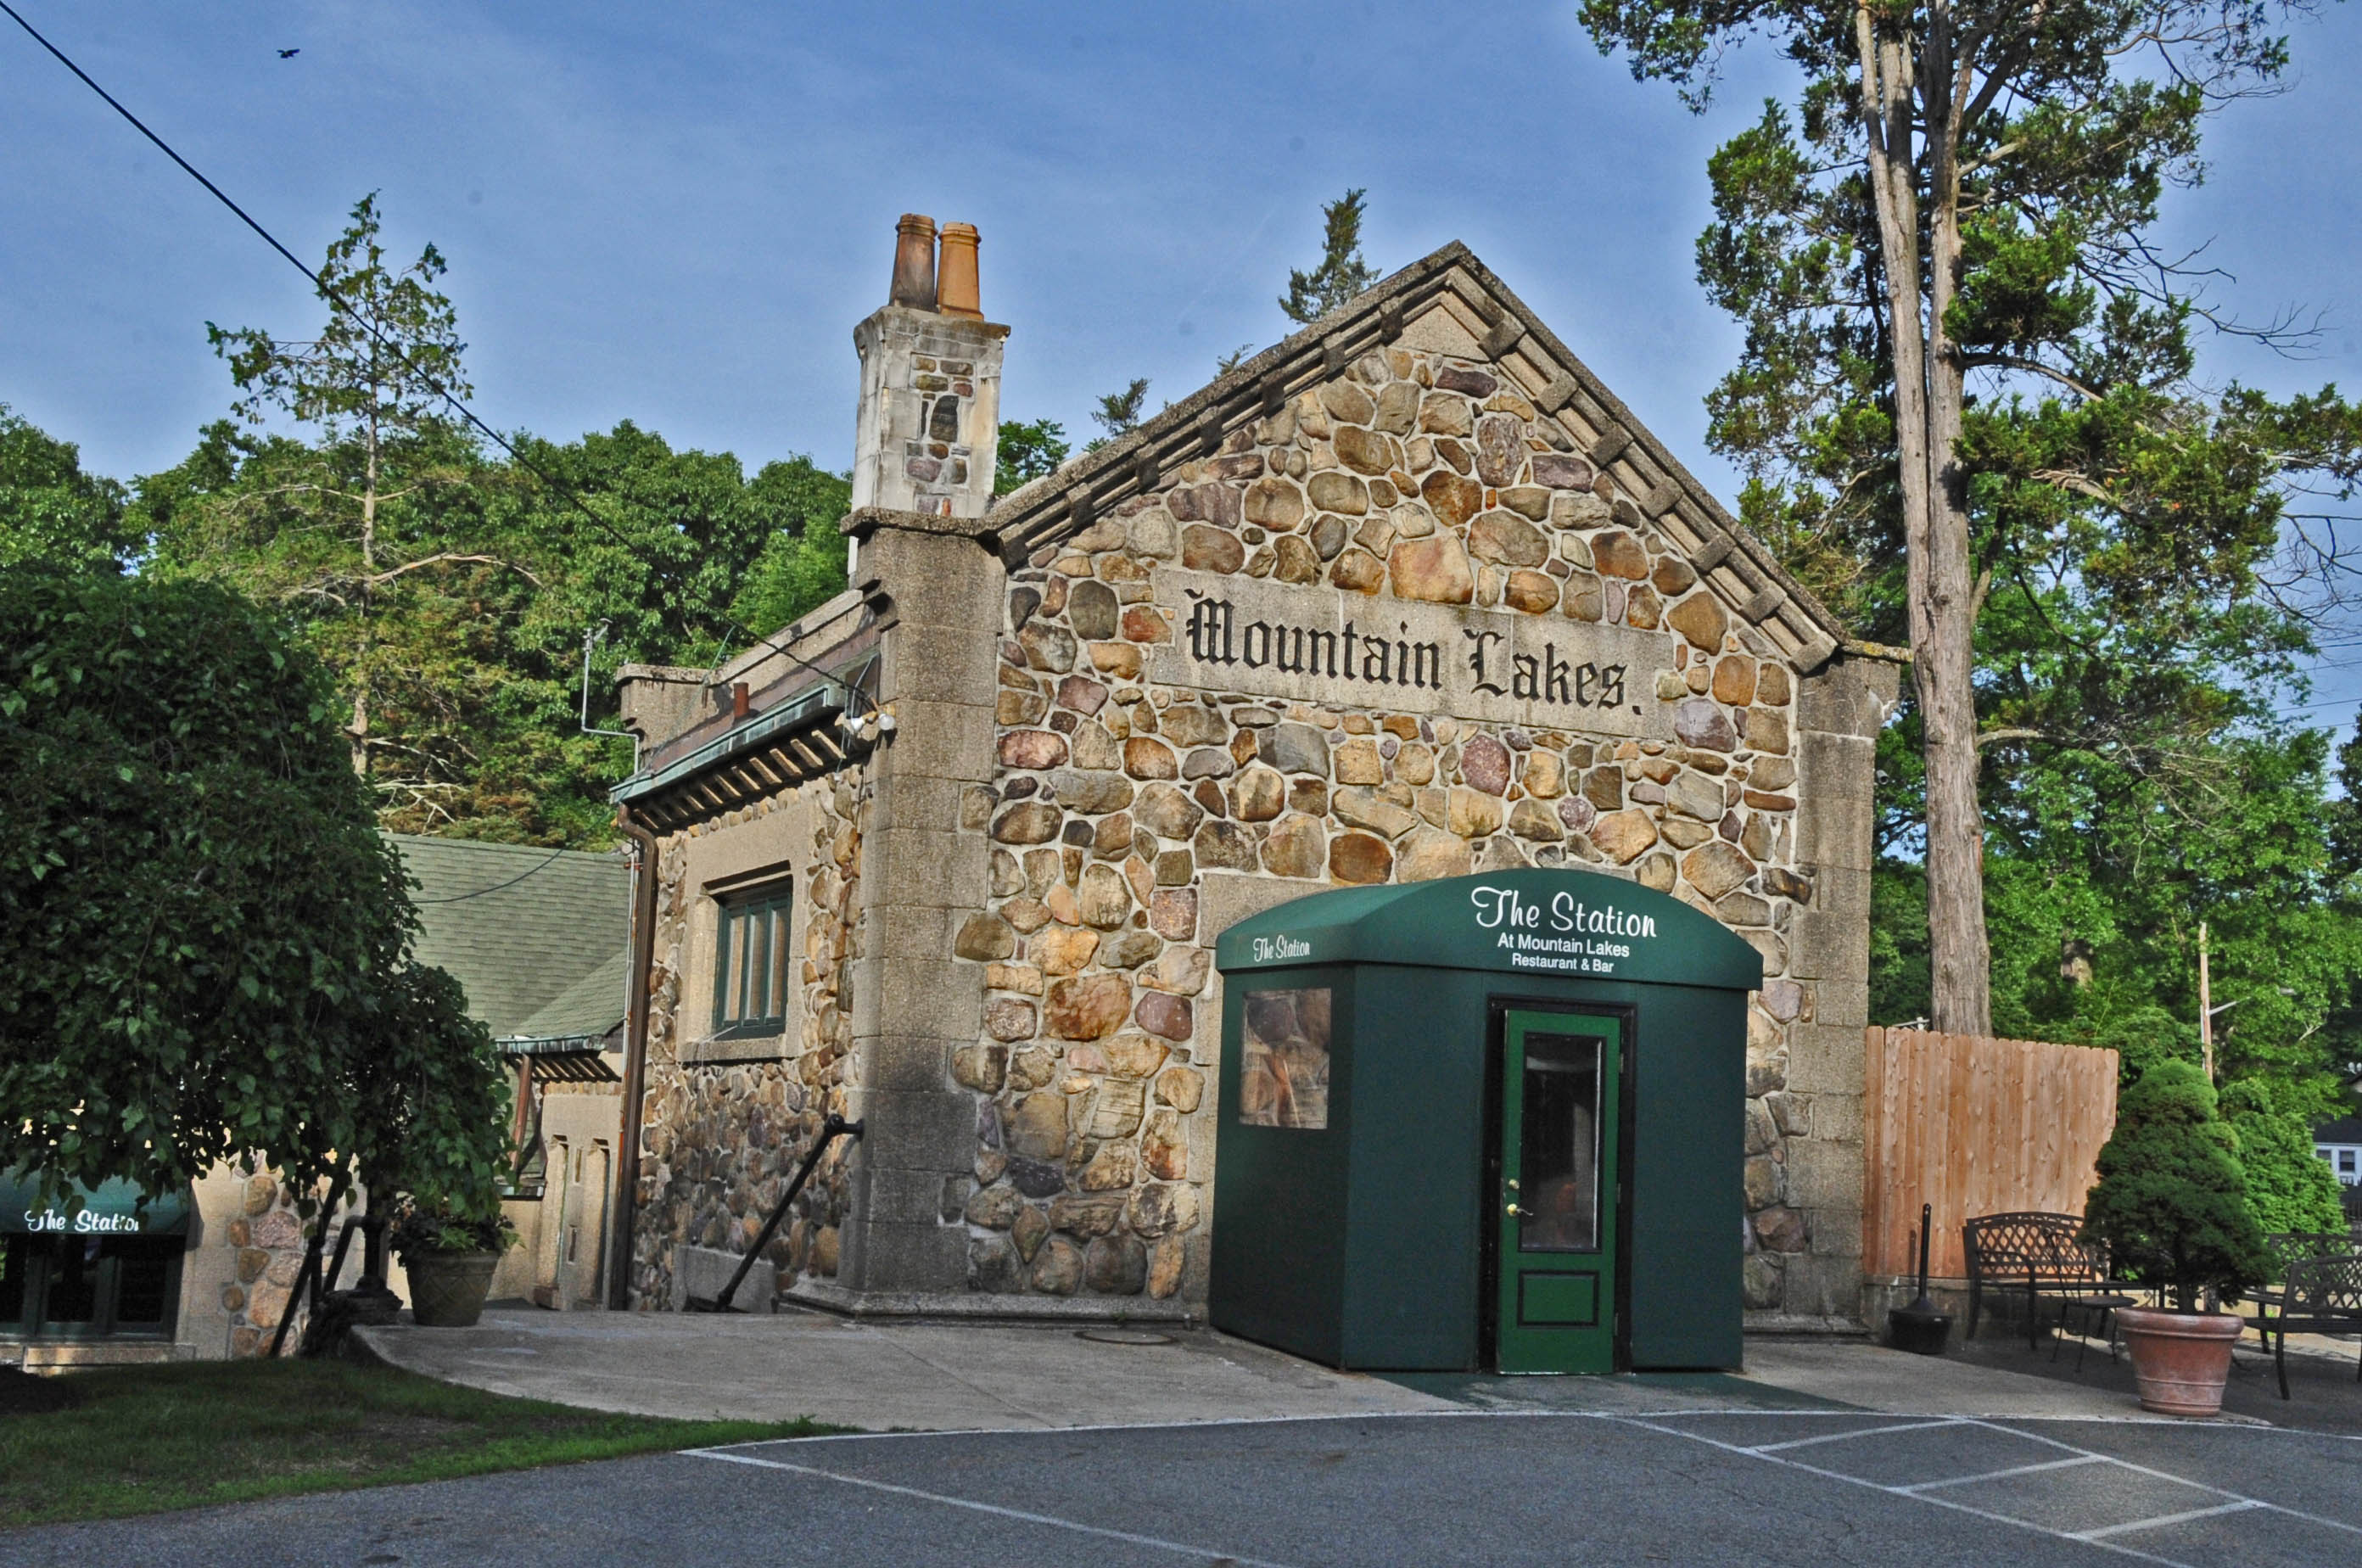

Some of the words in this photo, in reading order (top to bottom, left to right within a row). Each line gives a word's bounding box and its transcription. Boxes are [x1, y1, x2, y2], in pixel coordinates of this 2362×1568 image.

[1185, 588, 1442, 691] Mountain
[1471, 886, 1540, 928] The
[1550, 891, 1657, 938] Station
[1252, 937, 1273, 962] The
[1275, 934, 1310, 959] Station
[1497, 932, 1514, 949] At
[1518, 934, 1583, 954] Mountain
[1587, 938, 1630, 957] Lakes
[1512, 952, 1577, 970] Restaurant
[1581, 959, 1590, 972] &
[1592, 960, 1615, 973] Bar
[24, 1208, 66, 1232] The
